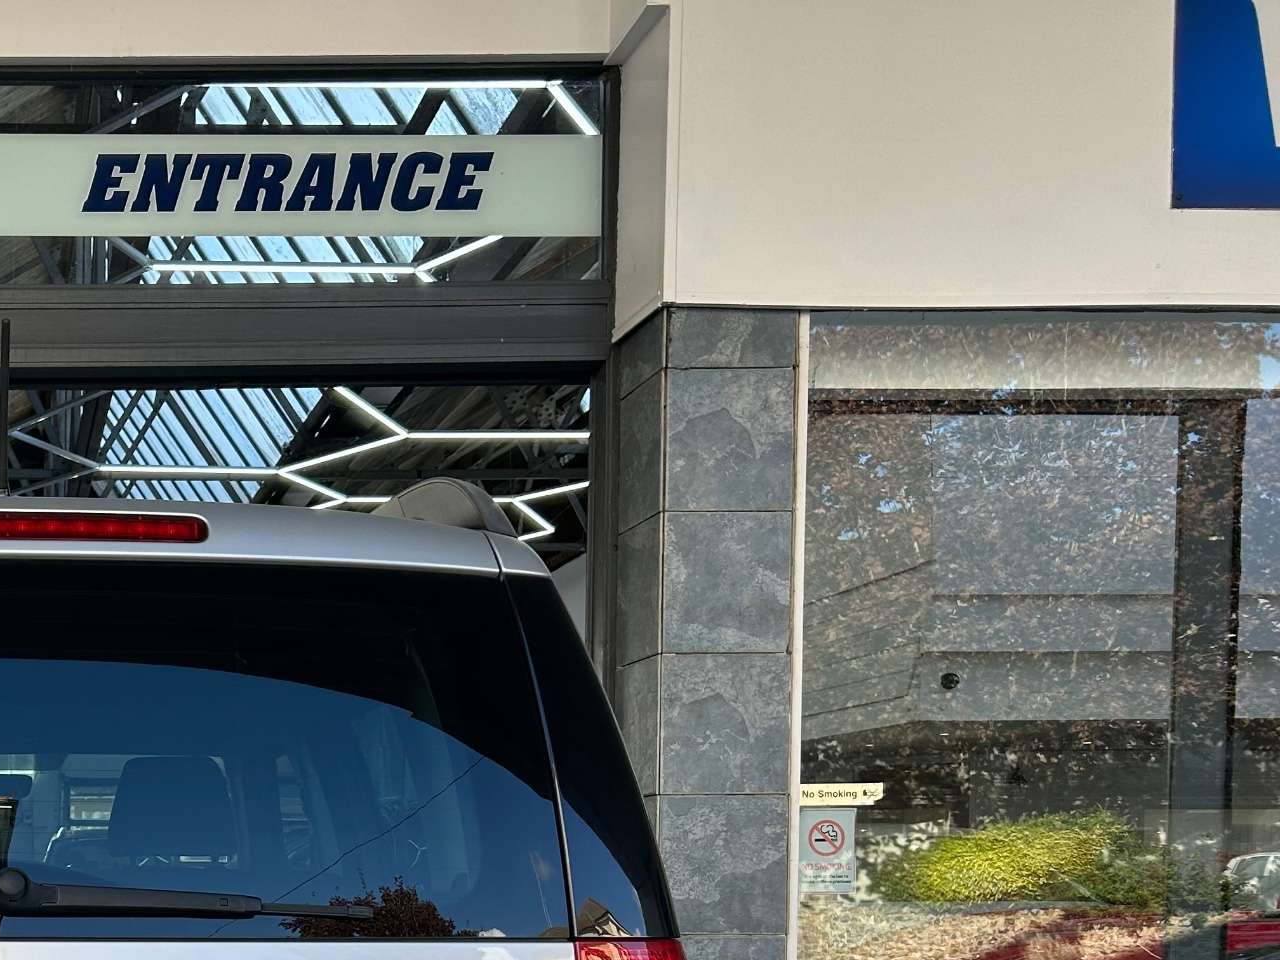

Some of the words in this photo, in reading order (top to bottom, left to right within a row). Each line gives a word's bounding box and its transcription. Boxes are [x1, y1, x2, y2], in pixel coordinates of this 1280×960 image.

[81, 151, 495, 213] ENTRANCE
[802, 790, 815, 798] No
[818, 790, 858, 799] Smoking
